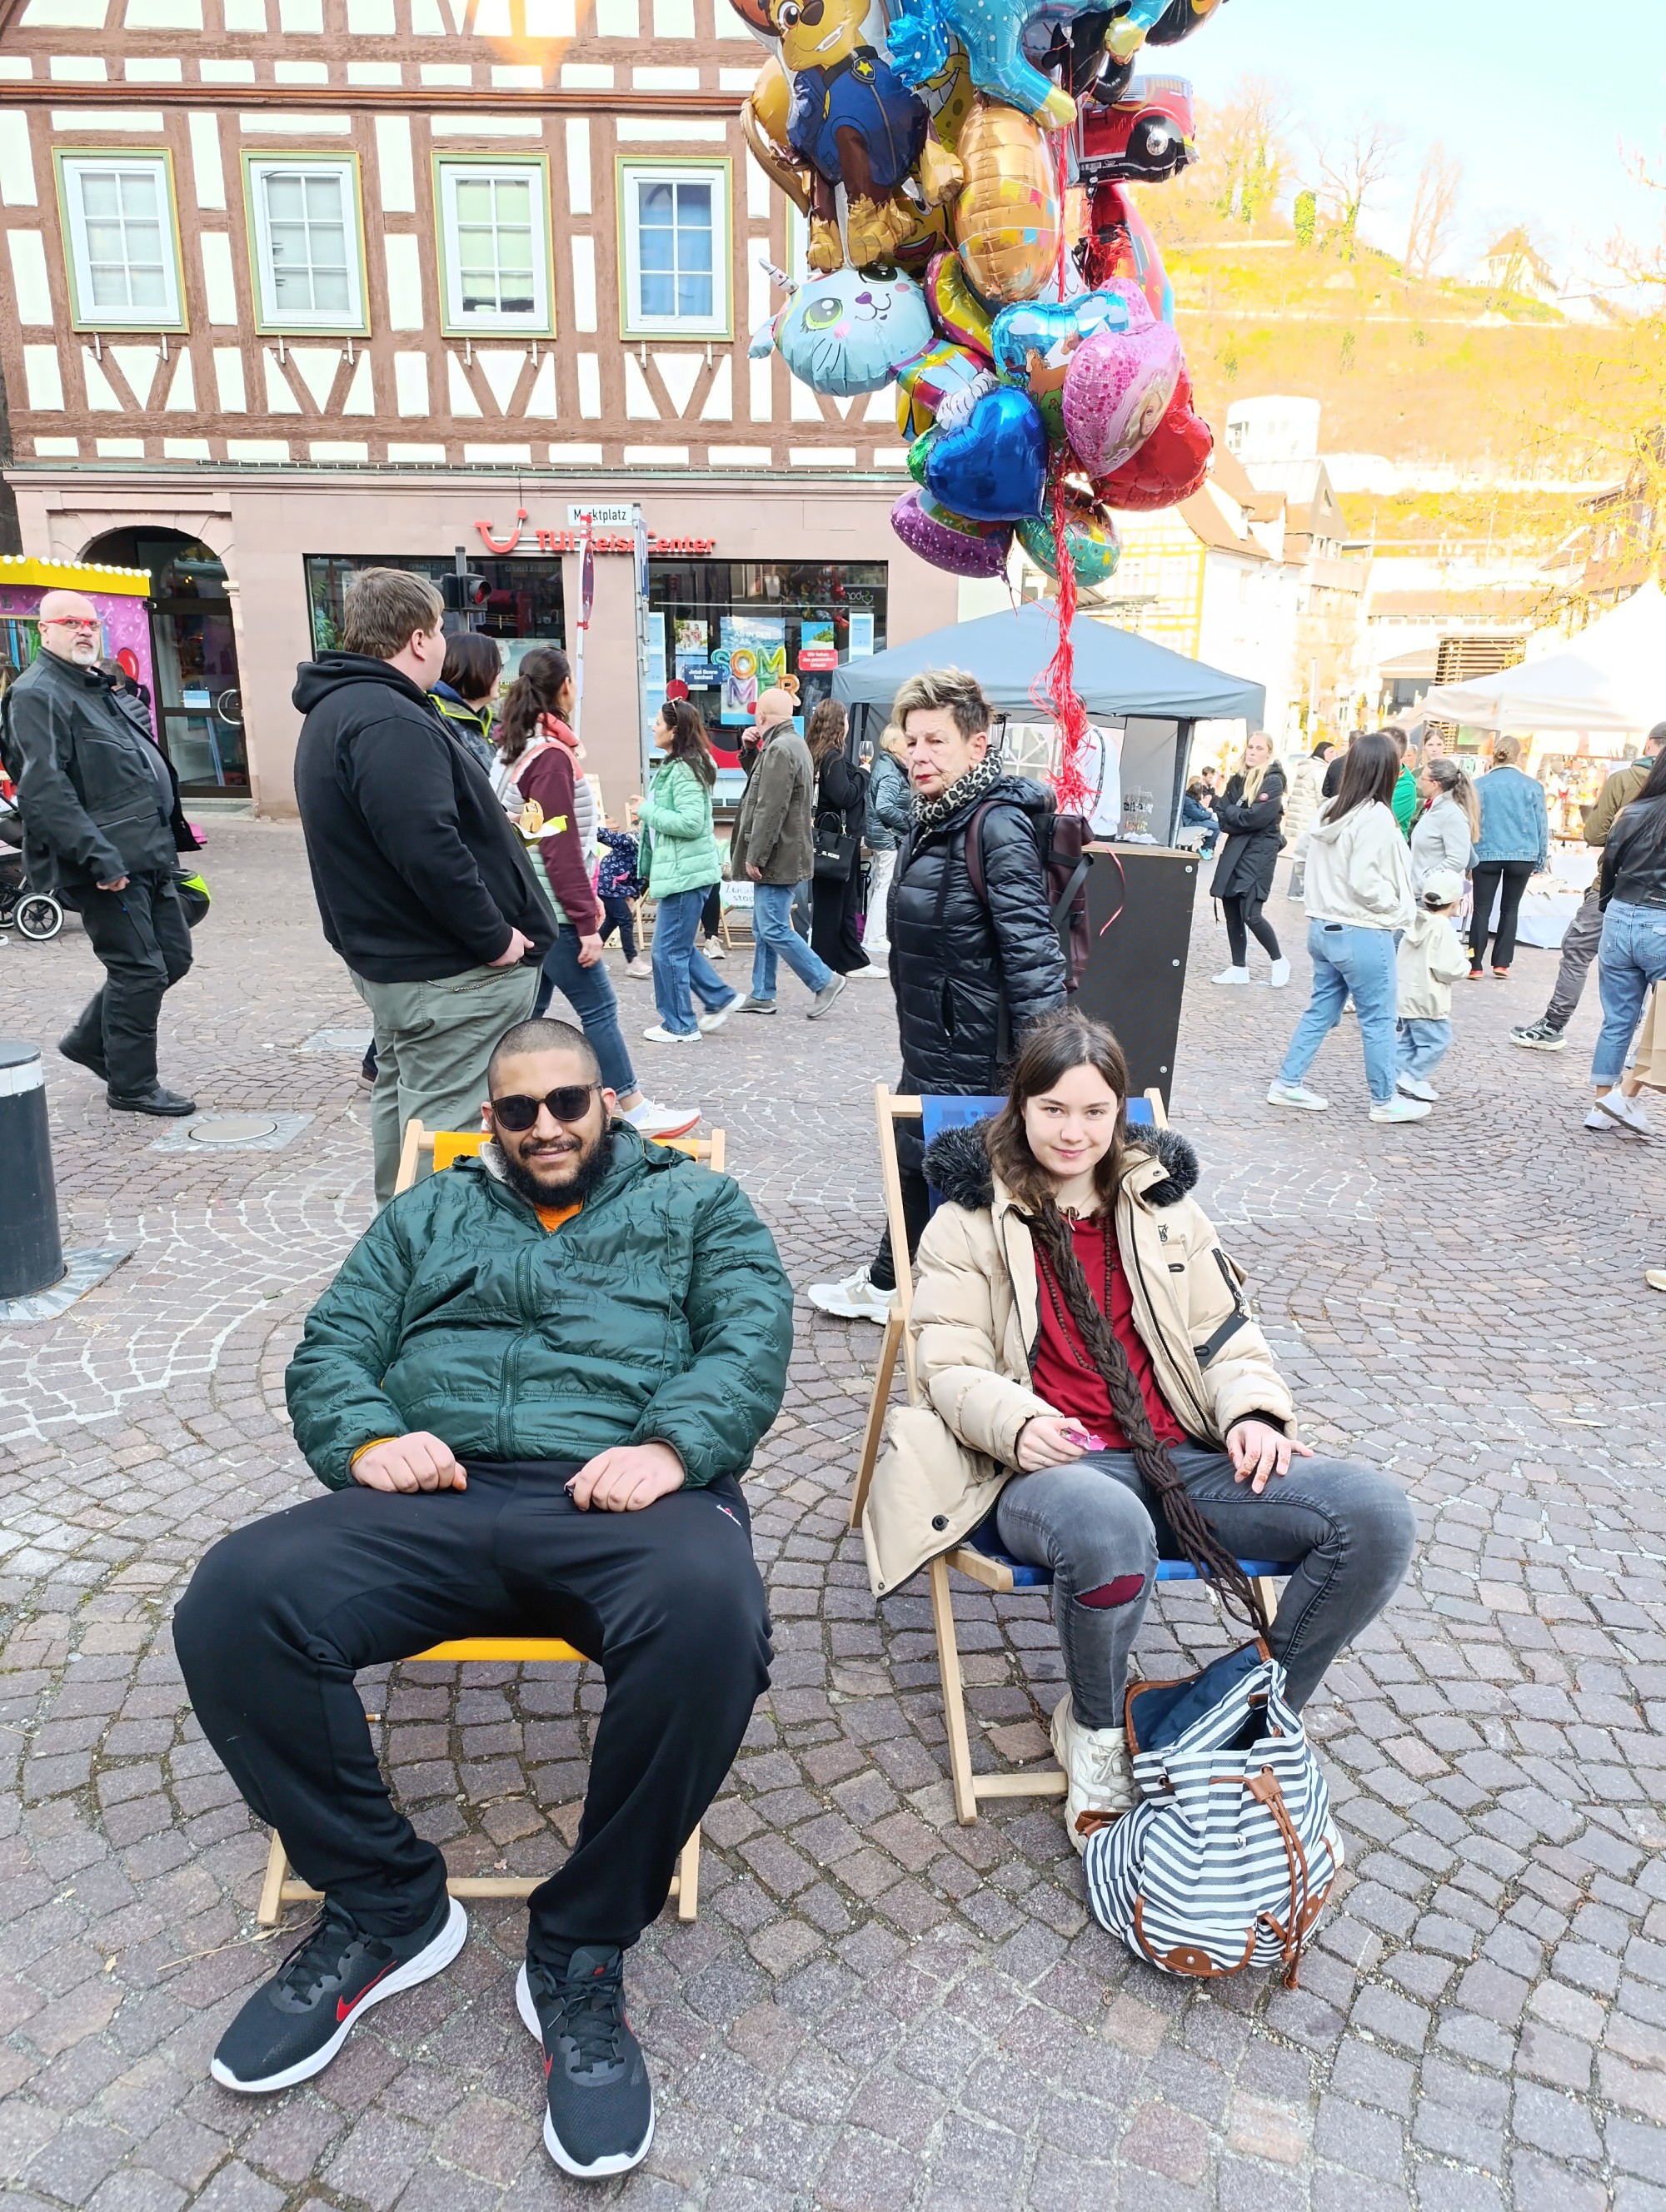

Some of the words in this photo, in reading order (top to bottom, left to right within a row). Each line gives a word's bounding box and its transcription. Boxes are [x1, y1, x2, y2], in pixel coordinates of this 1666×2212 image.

[574, 509, 626, 523] Mrktplatz
[536, 530, 575, 551] TUI
[711, 645, 786, 681] SOM
